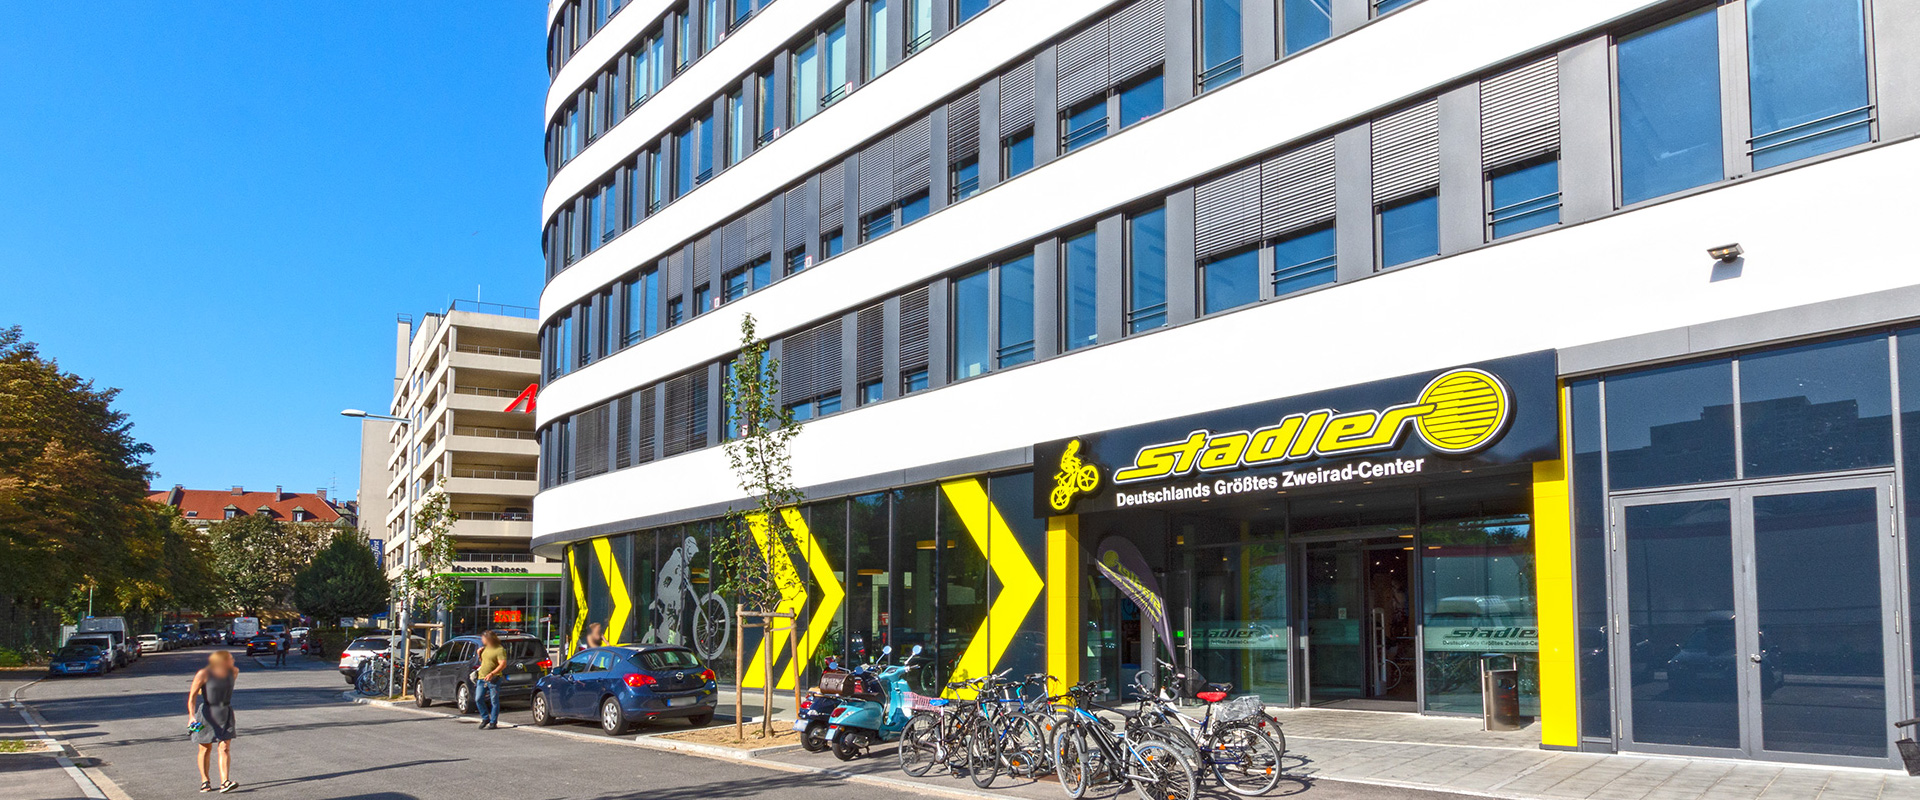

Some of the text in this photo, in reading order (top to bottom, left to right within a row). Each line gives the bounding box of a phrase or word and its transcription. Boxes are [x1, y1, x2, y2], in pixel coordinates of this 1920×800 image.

[1113, 404, 1437, 484] stadler
[1116, 458, 1425, 507] Deutschlands Größtes Zweirad-Center
[1445, 627, 1539, 639] stadle
